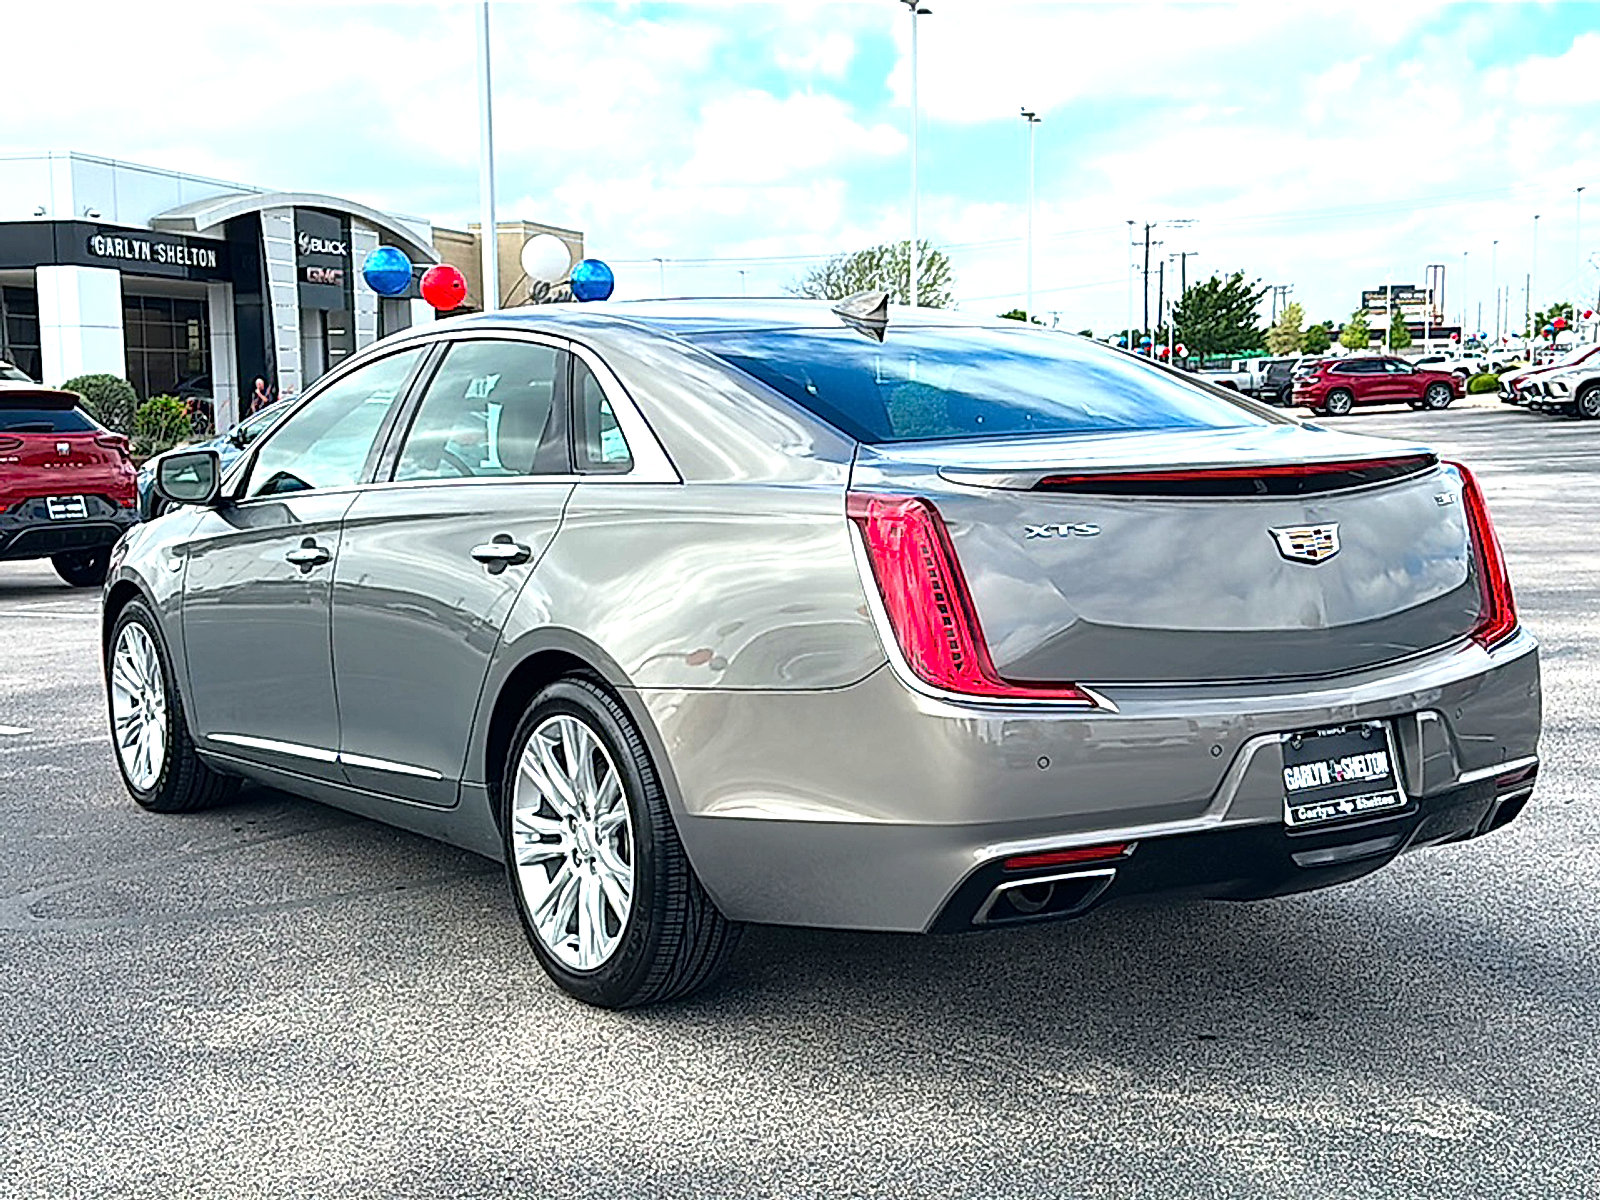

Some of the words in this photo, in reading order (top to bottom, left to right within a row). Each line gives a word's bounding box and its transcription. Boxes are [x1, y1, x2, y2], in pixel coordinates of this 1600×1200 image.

[93, 235, 151, 261] GARLYN
[158, 243, 217, 268] SHELTON
[311, 238, 347, 256] BUICK
[1024, 523, 1101, 539] XTS
[1284, 761, 1331, 791] GARLYN
[1341, 751, 1389, 780] SHELTON
